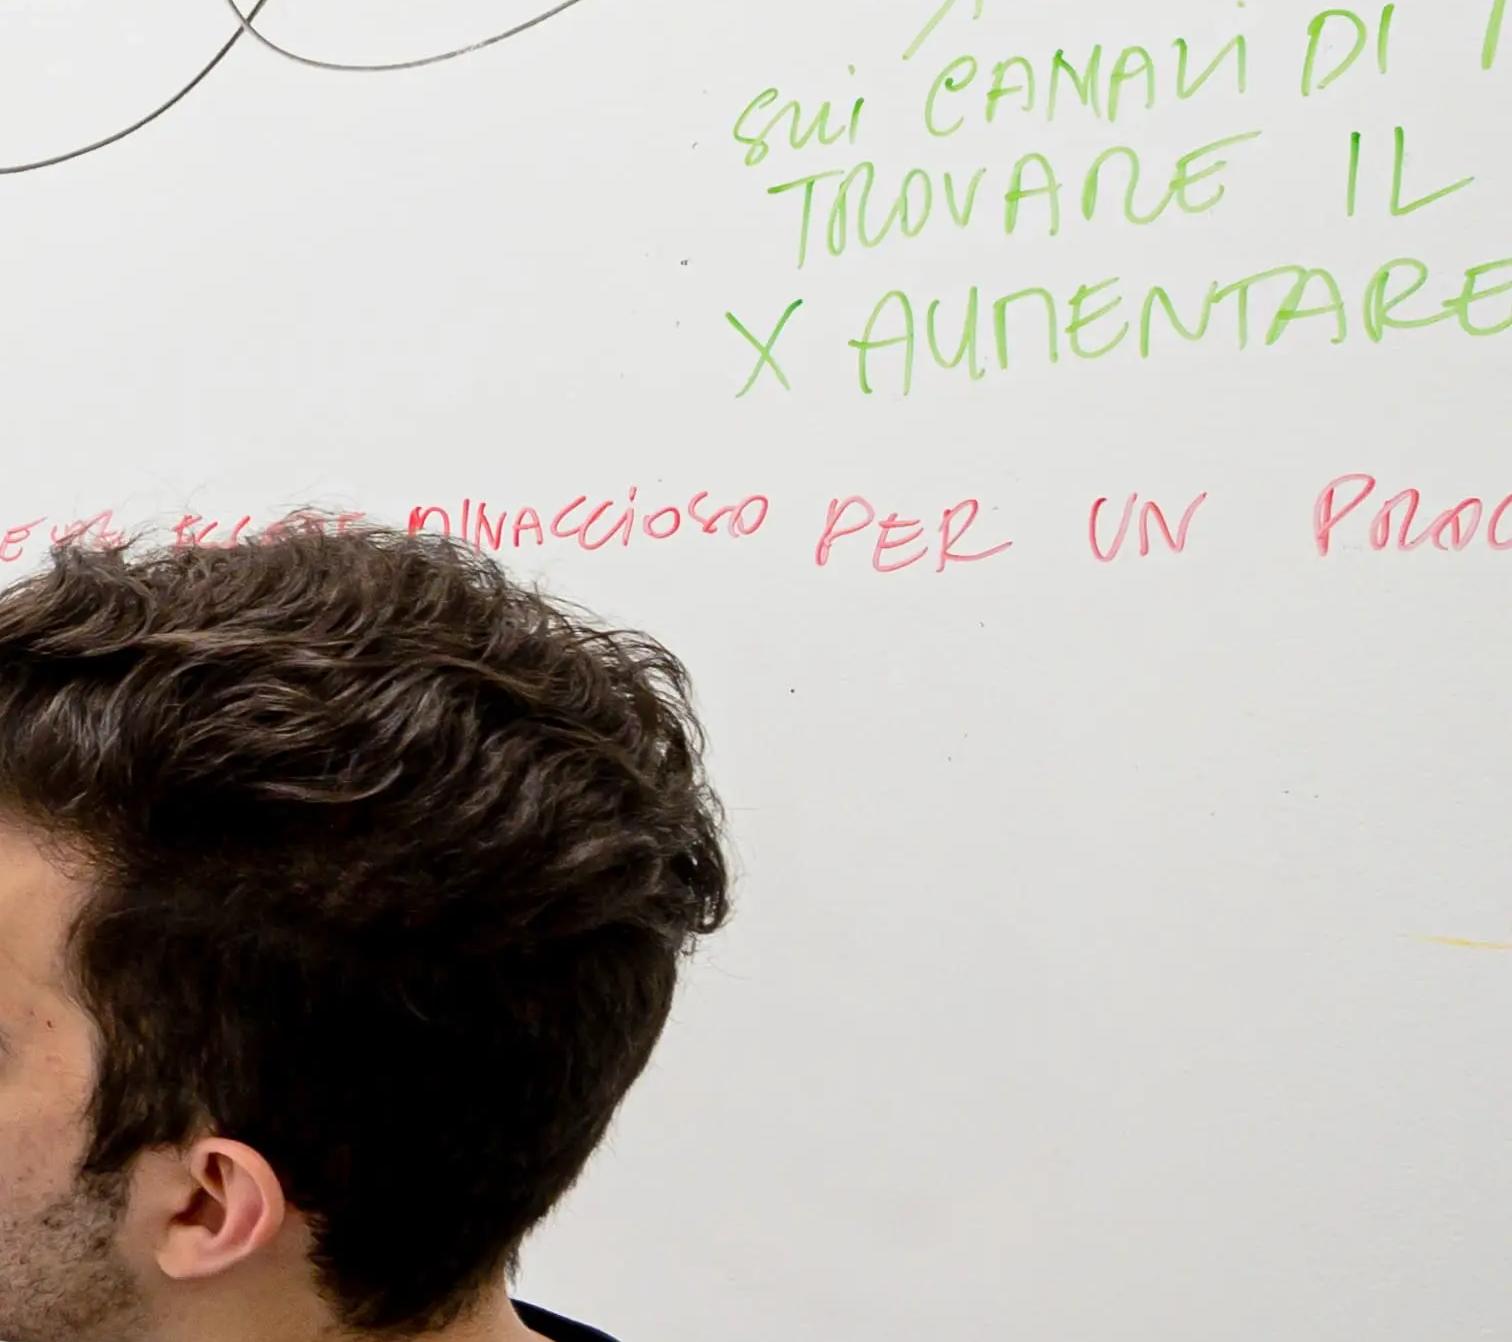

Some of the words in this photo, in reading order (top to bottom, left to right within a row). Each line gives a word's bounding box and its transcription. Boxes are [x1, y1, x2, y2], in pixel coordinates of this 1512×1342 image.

[1300, 3, 1396, 98] DI
[766, 129, 1264, 271] TROVARE
[1347, 125, 1476, 219] IL
[847, 256, 1512, 398] AUMENTARE
[815, 495, 1015, 576] PER
[1088, 490, 1211, 564] UN
